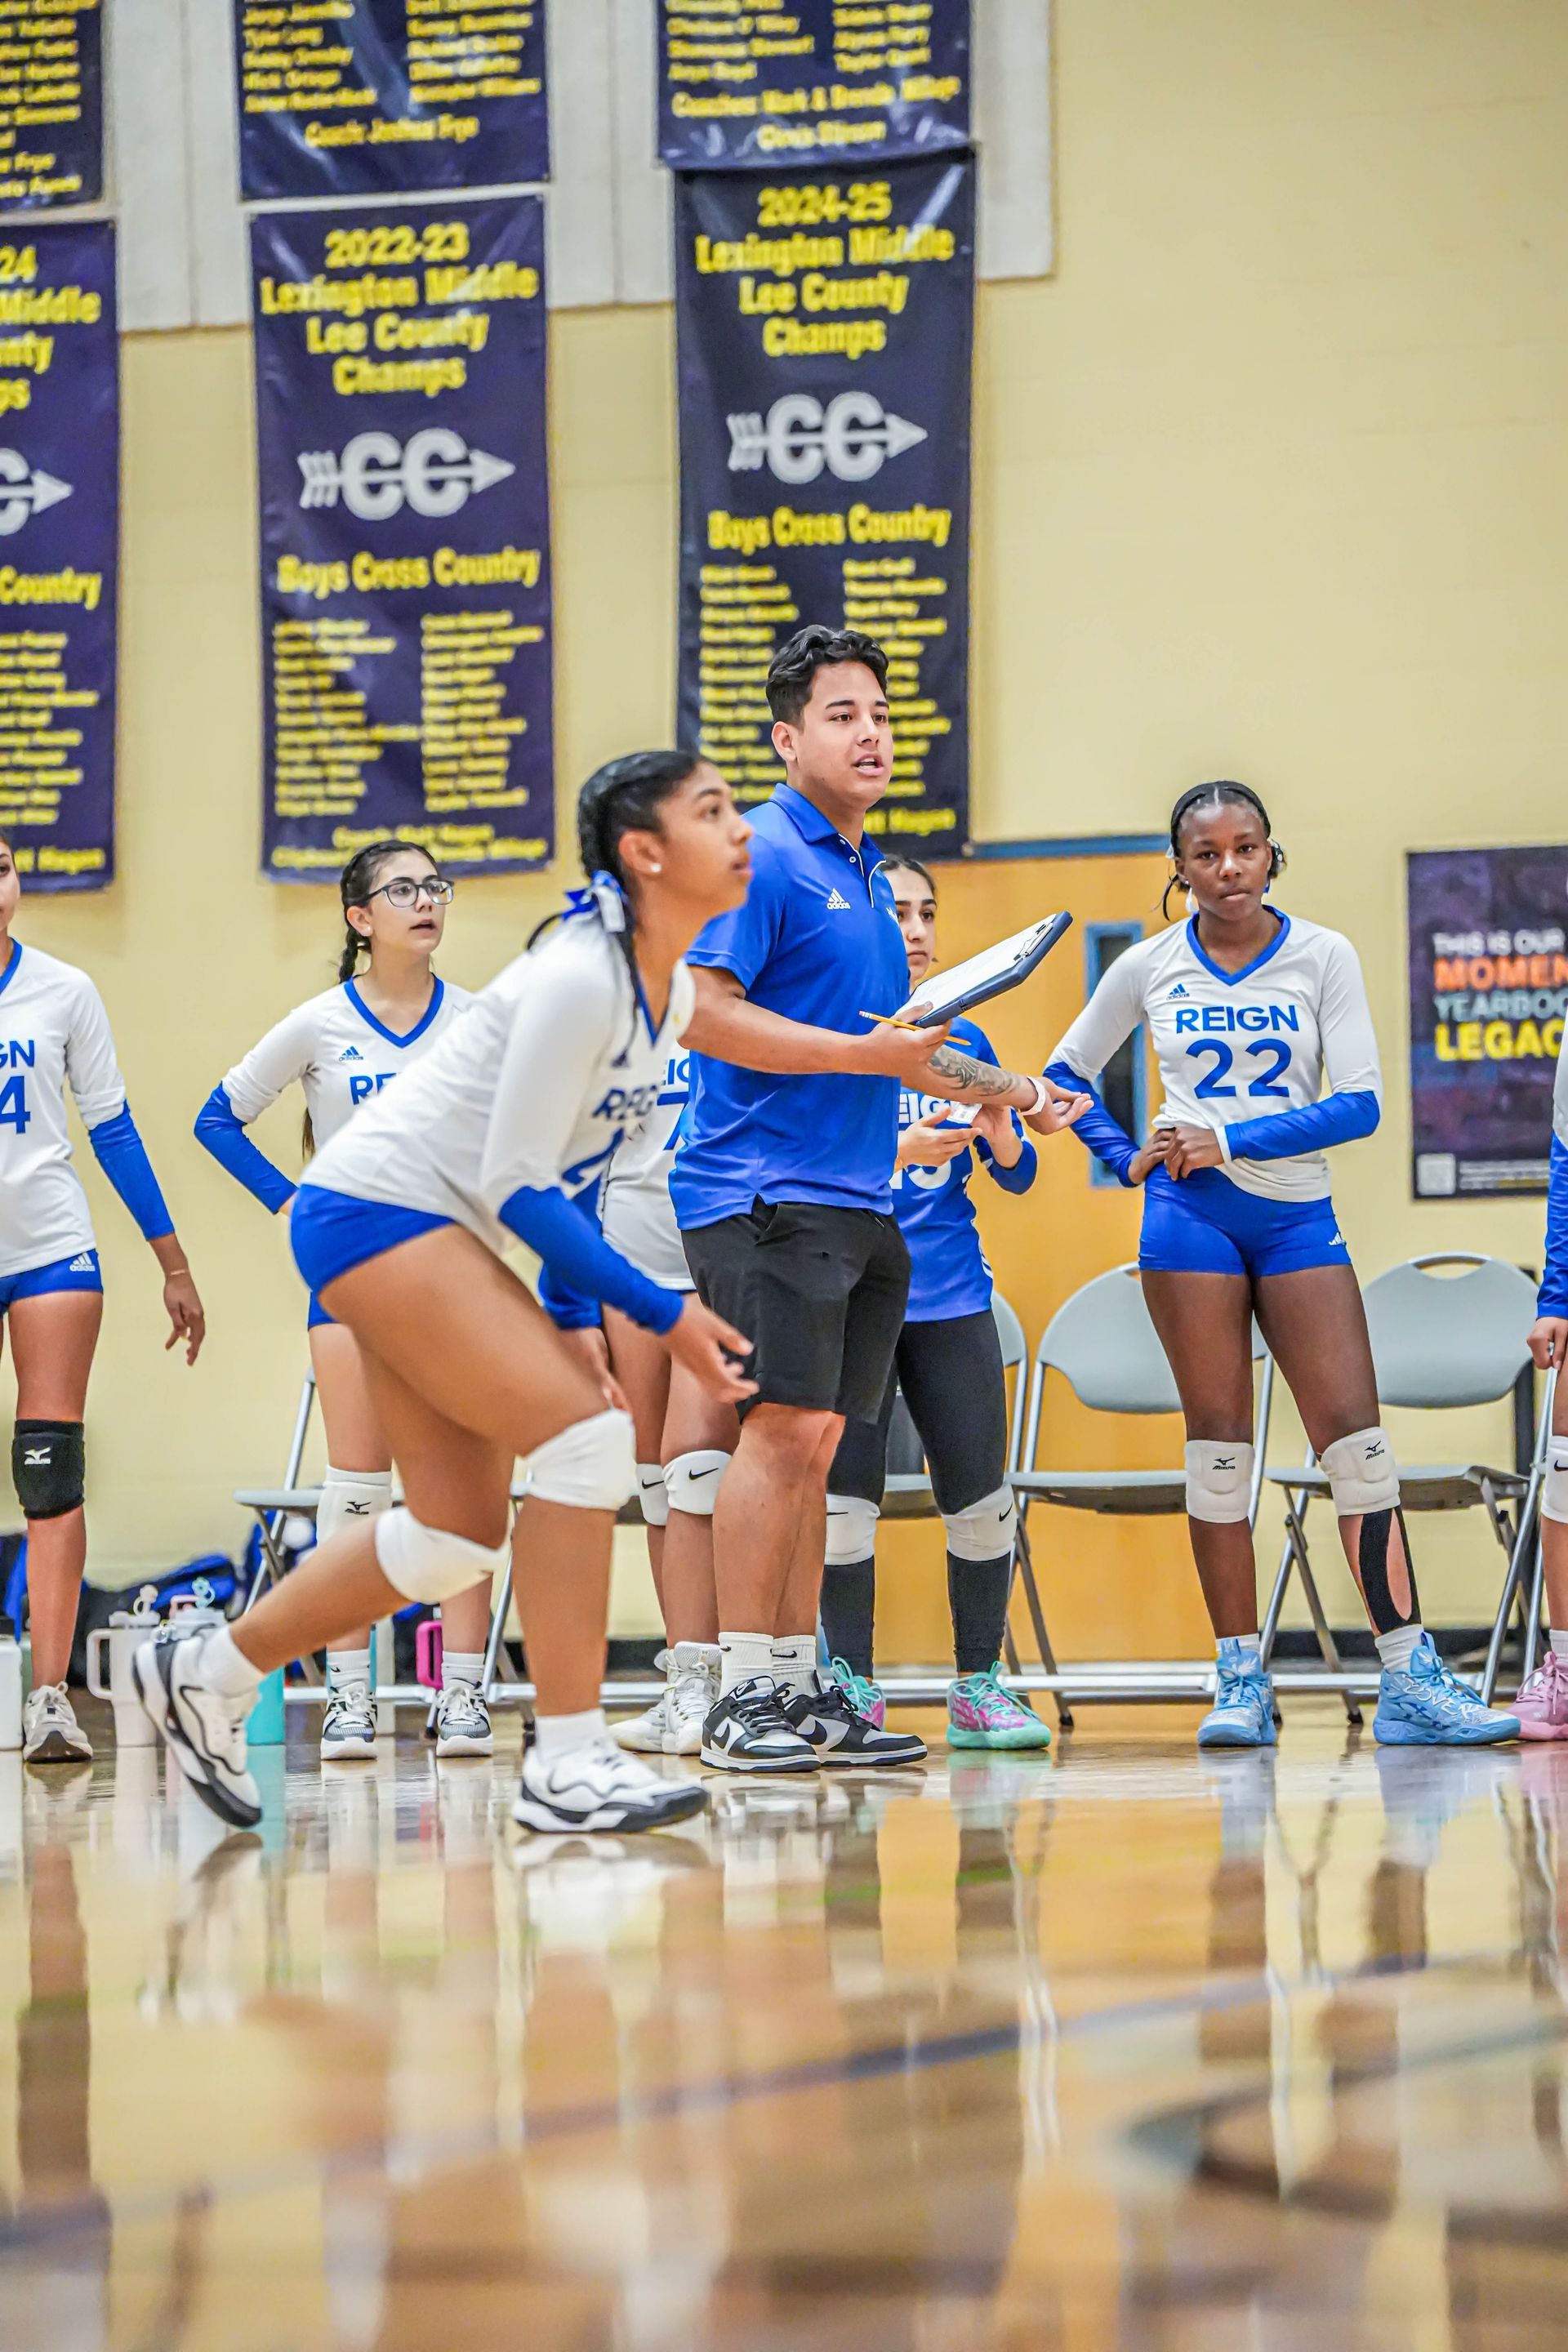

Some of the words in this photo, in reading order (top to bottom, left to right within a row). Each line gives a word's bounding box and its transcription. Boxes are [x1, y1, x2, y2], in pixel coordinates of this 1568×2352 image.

[757, 180, 893, 228] 2024-25
[324, 221, 470, 269] 2022-23
[695, 232, 844, 277] Lexington
[848, 223, 955, 265] Middle
[260, 274, 420, 317] Lexington
[425, 261, 540, 305] Middle
[738, 276, 796, 314] Lee
[801, 270, 909, 314] County
[306, 316, 367, 354] Lee
[374, 308, 490, 352] County
[763, 317, 887, 360] Champs
[332, 355, 467, 398] Champs
[707, 510, 771, 556] Boys
[773, 506, 846, 546] Cross
[848, 501, 951, 548] Country
[0, 565, 102, 611] Country
[277, 554, 350, 599] Boys
[351, 551, 430, 591] Cross
[433, 546, 541, 589] Country
[826, 901, 851, 910] adidas
[1433, 931, 1485, 956] THIS
[1486, 929, 1512, 956] IS
[1514, 928, 1566, 955] OUR
[1166, 992, 1190, 1000] adidas
[1175, 1004, 1300, 1034] REIGN
[1185, 1038, 1293, 1099] 22
